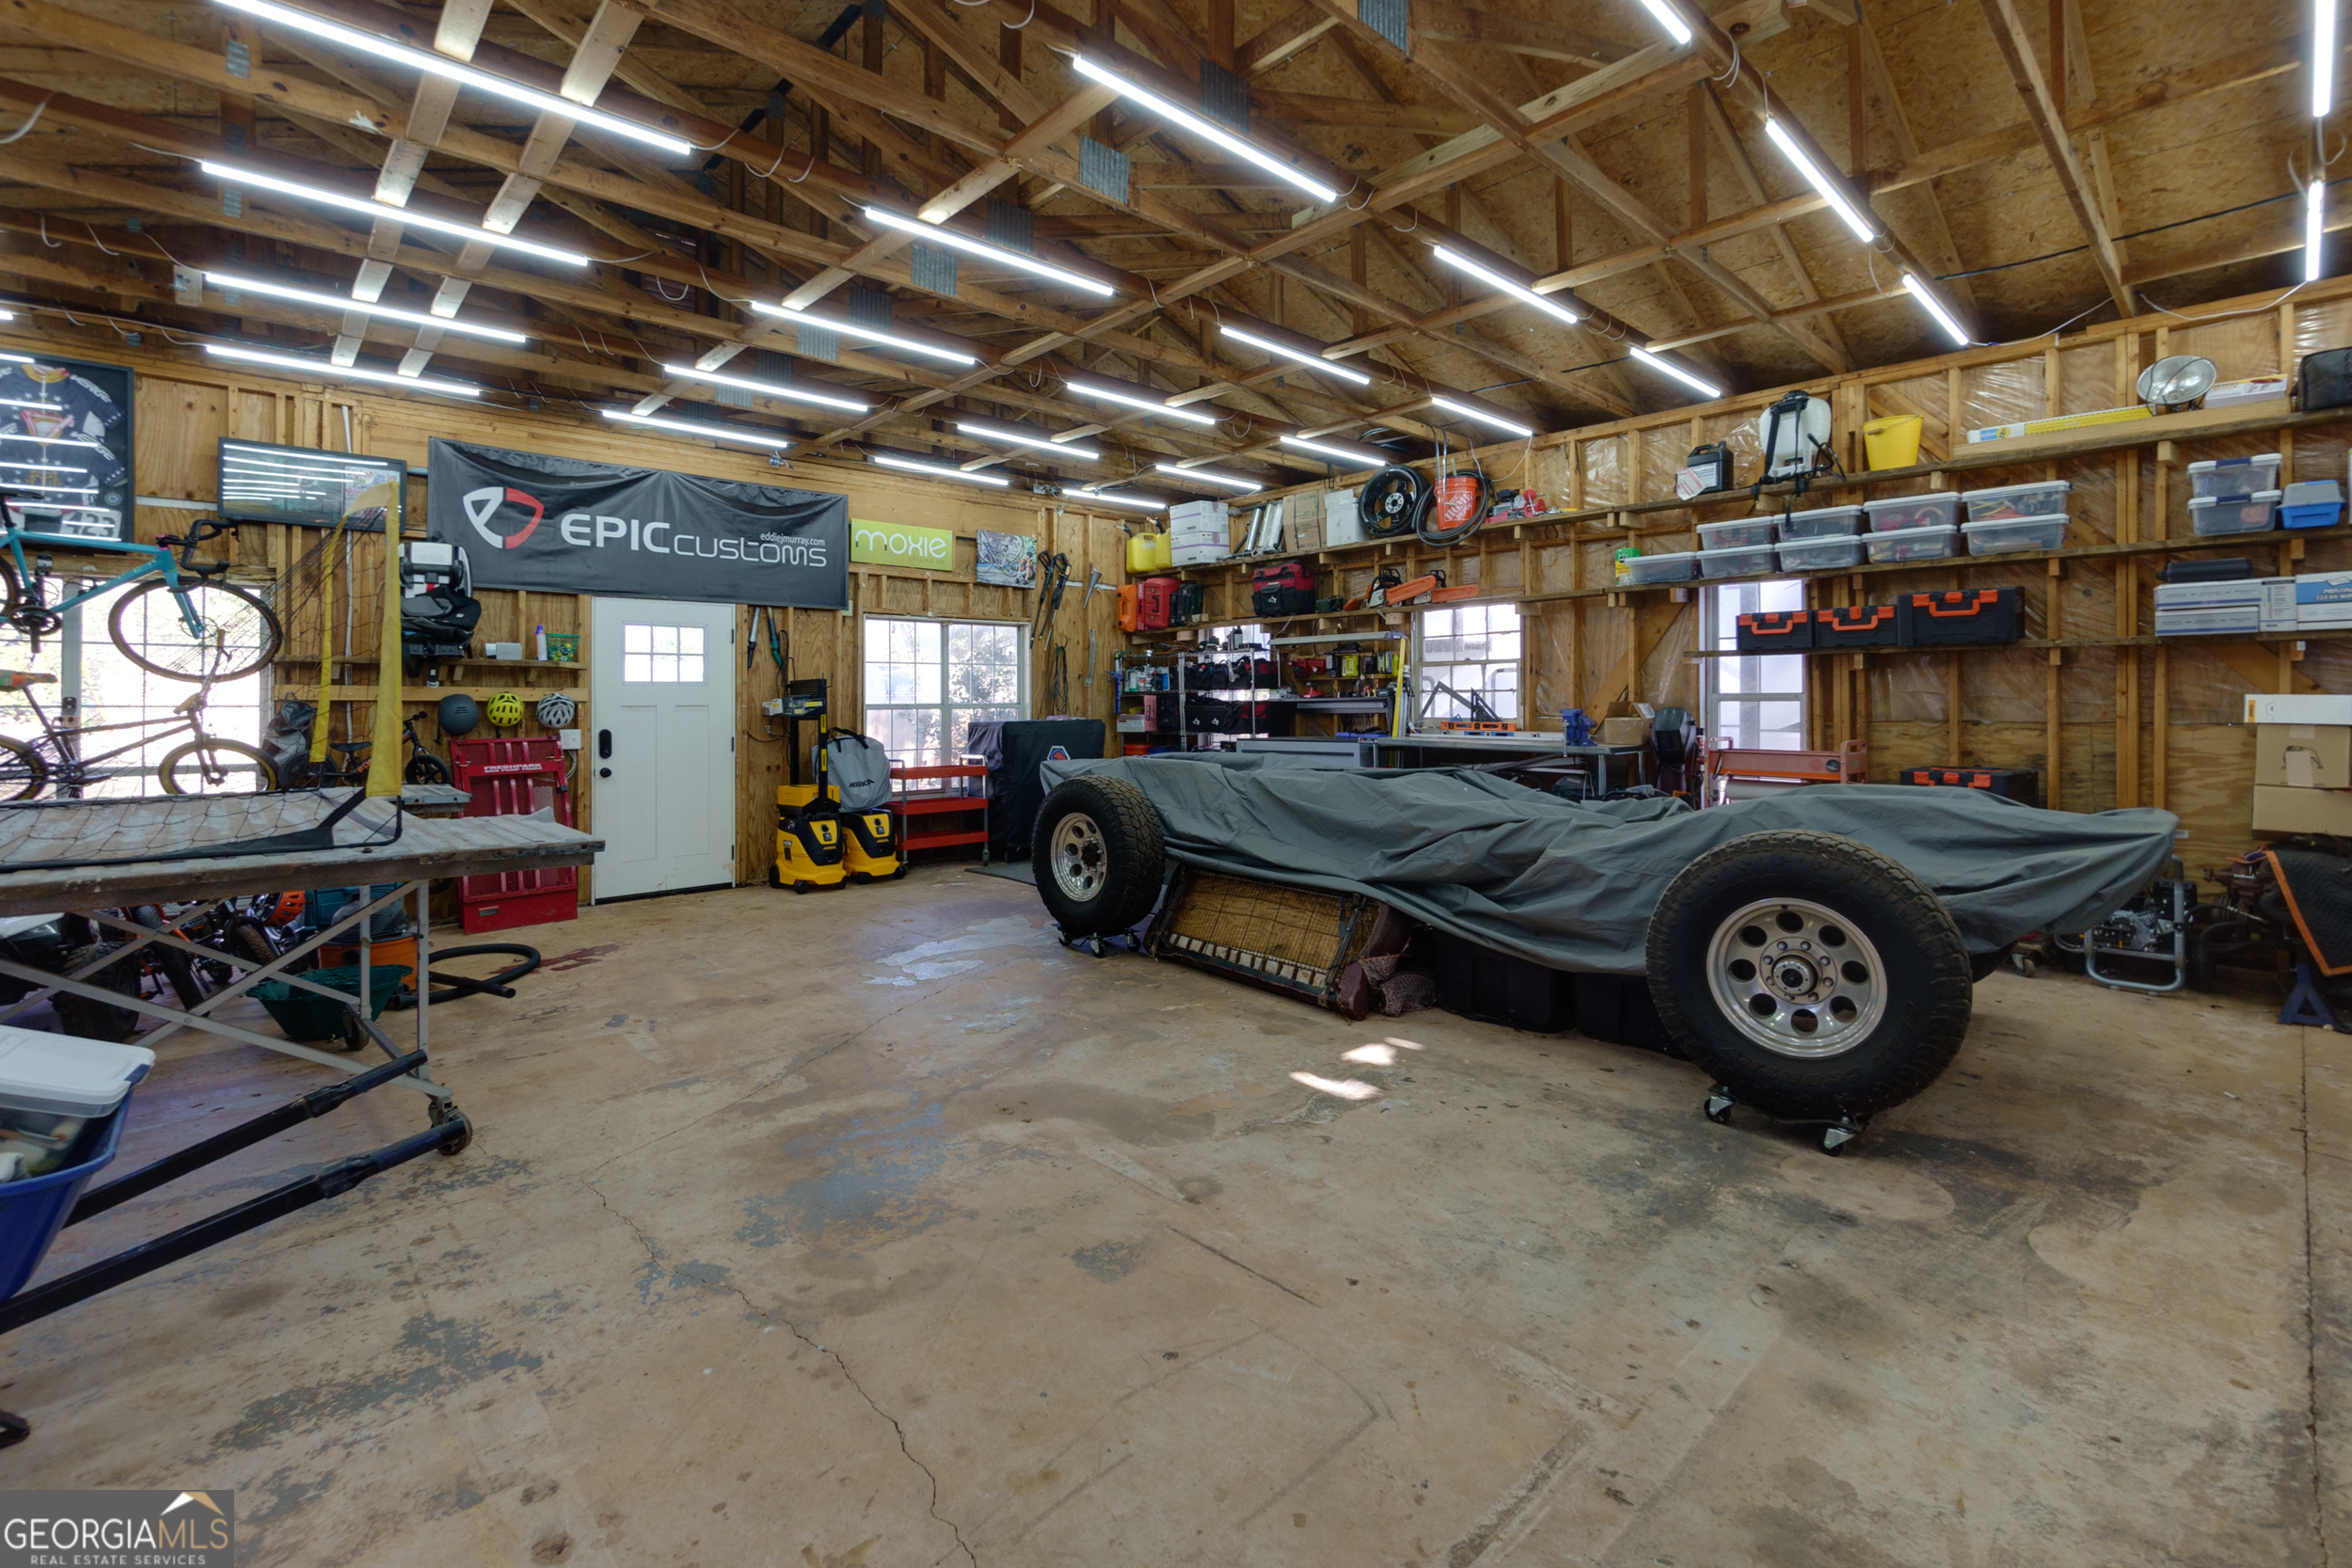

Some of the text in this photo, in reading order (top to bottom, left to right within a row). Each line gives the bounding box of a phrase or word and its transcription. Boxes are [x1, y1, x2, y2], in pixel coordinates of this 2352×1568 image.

[1444, 491, 1472, 520] HOME
[1455, 502, 1472, 520] DEPOT
[66, 511, 117, 538] 423
[560, 513, 671, 554] EPIC
[759, 531, 826, 546] eddiejmurray.com
[908, 556, 934, 564] CYCLING
[484, 763, 543, 771] FRESHPARK
[848, 778, 876, 788] MIRKA
[1719, 999, 1919, 1087] OPEN COUNTRY
